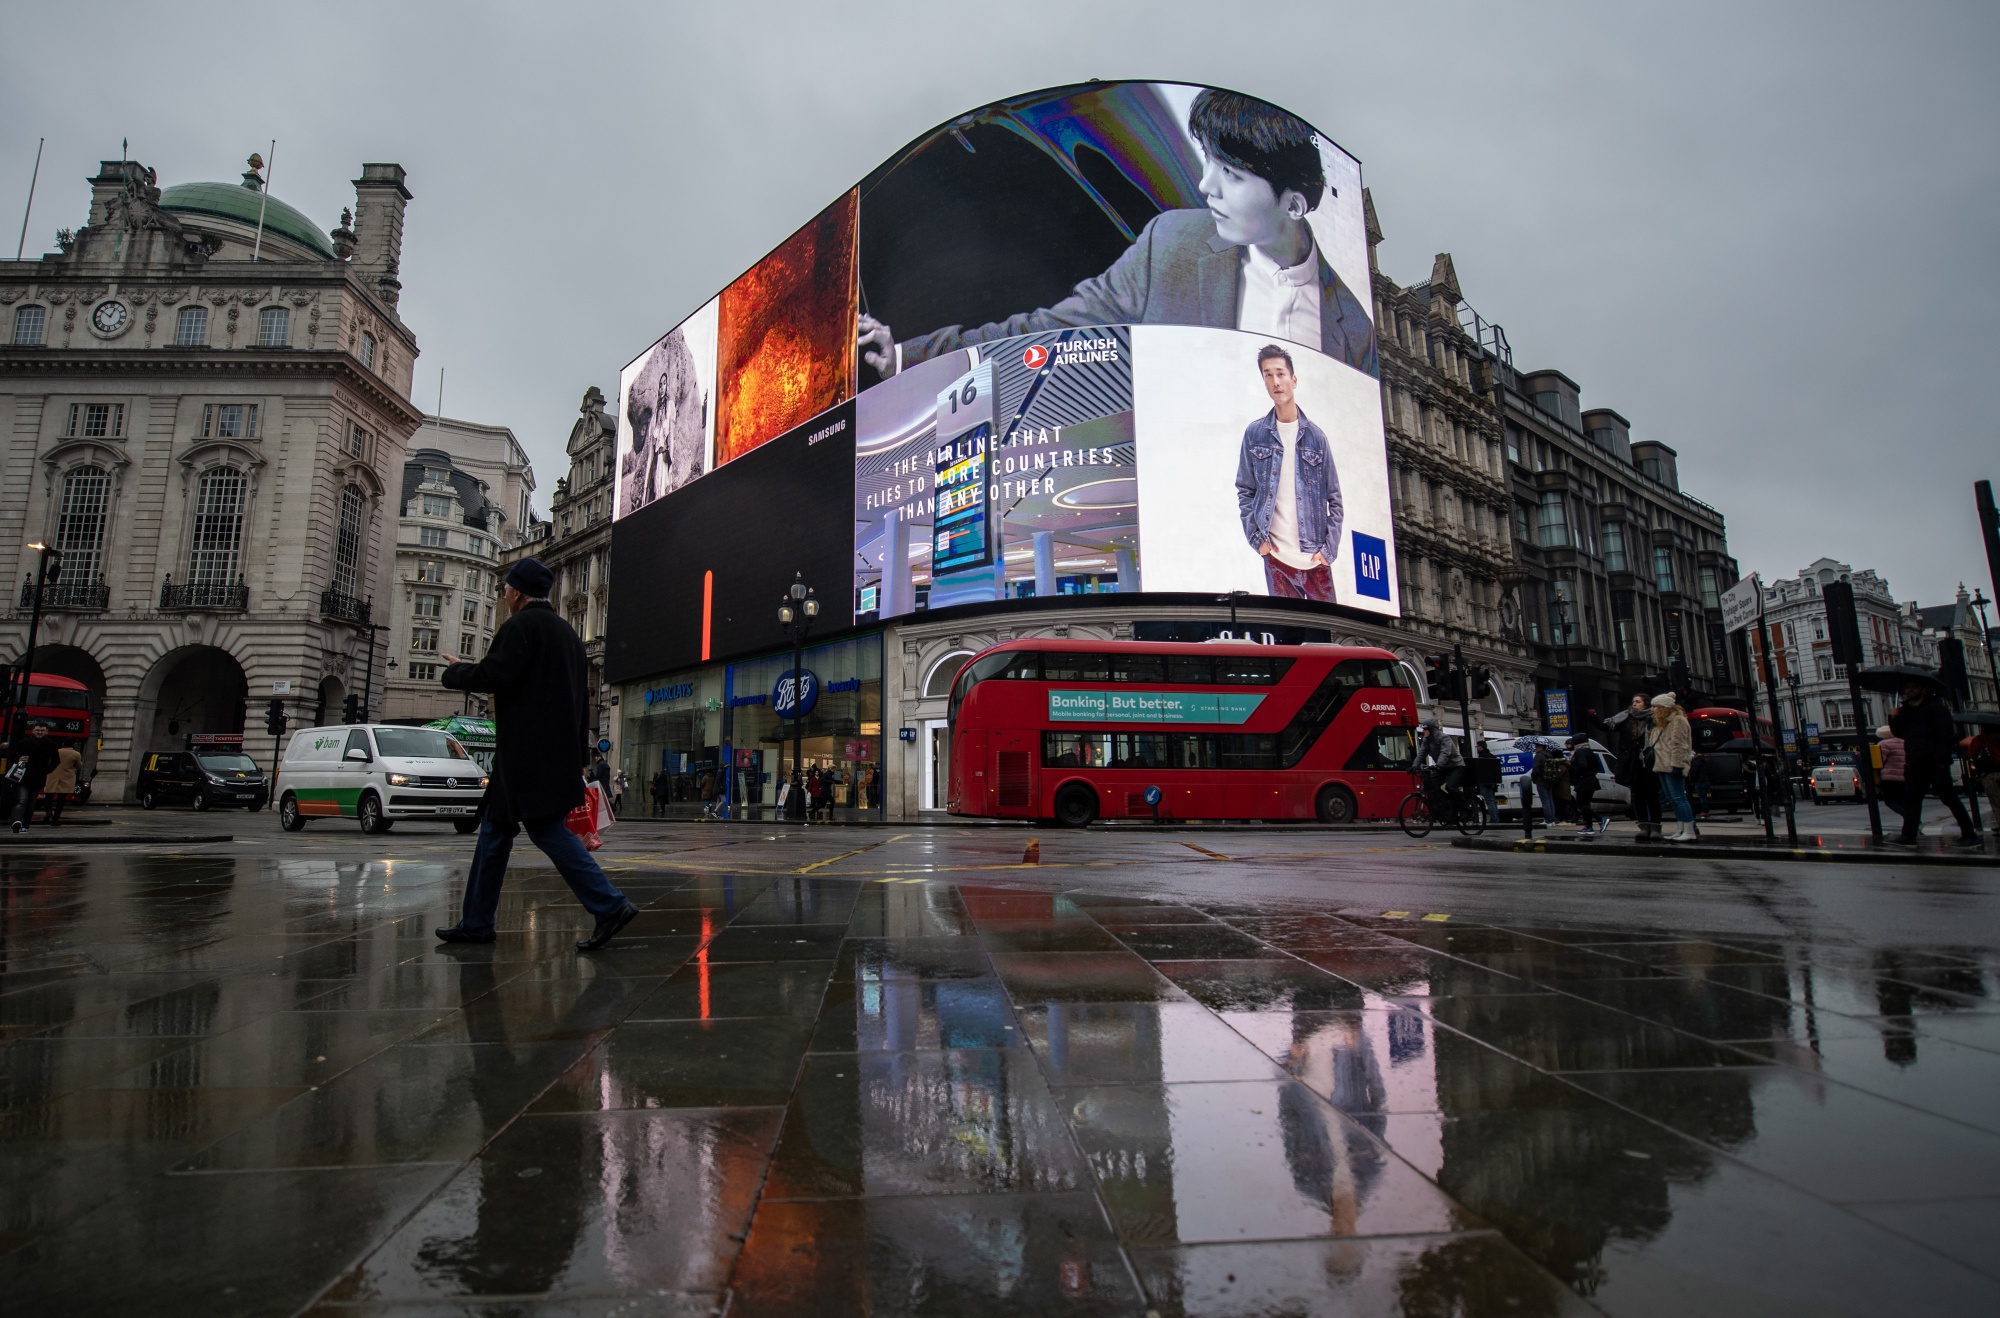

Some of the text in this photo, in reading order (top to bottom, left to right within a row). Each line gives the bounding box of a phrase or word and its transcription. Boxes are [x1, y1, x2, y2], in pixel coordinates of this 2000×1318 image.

[1054, 338, 1117, 353] TURKISH
[1054, 350, 1119, 365] AIRLINES
[335, 389, 358, 411] ALLIANCE
[949, 377, 977, 414] 16
[808, 419, 846, 446] SAMSUNG
[894, 455, 918, 478] THE
[926, 435, 998, 466] AIRLINE
[1010, 426, 1062, 448] THAT
[867, 484, 900, 511] FLIES
[908, 477, 925, 495] TO
[934, 463, 980, 488] MORE
[992, 447, 1113, 475] COUNTRIES
[898, 477, 1055, 522] THAN ANY OTHER
[1361, 551, 1380, 580] GAP
[0, 613, 45, 621] COUNY
[653, 682, 693, 702] BARCLAYS
[775, 675, 810, 711] Bots
[828, 677, 860, 694] beauty
[729, 694, 766, 709] pharmacy
[1052, 696, 1183, 710] Banking. But better.
[66, 721, 79, 730] 453
[1703, 729, 1711, 737] 19
[323, 736, 340, 749] bam
[1820, 755, 1853, 763] Brewers
[1501, 765, 1525, 773] aners
